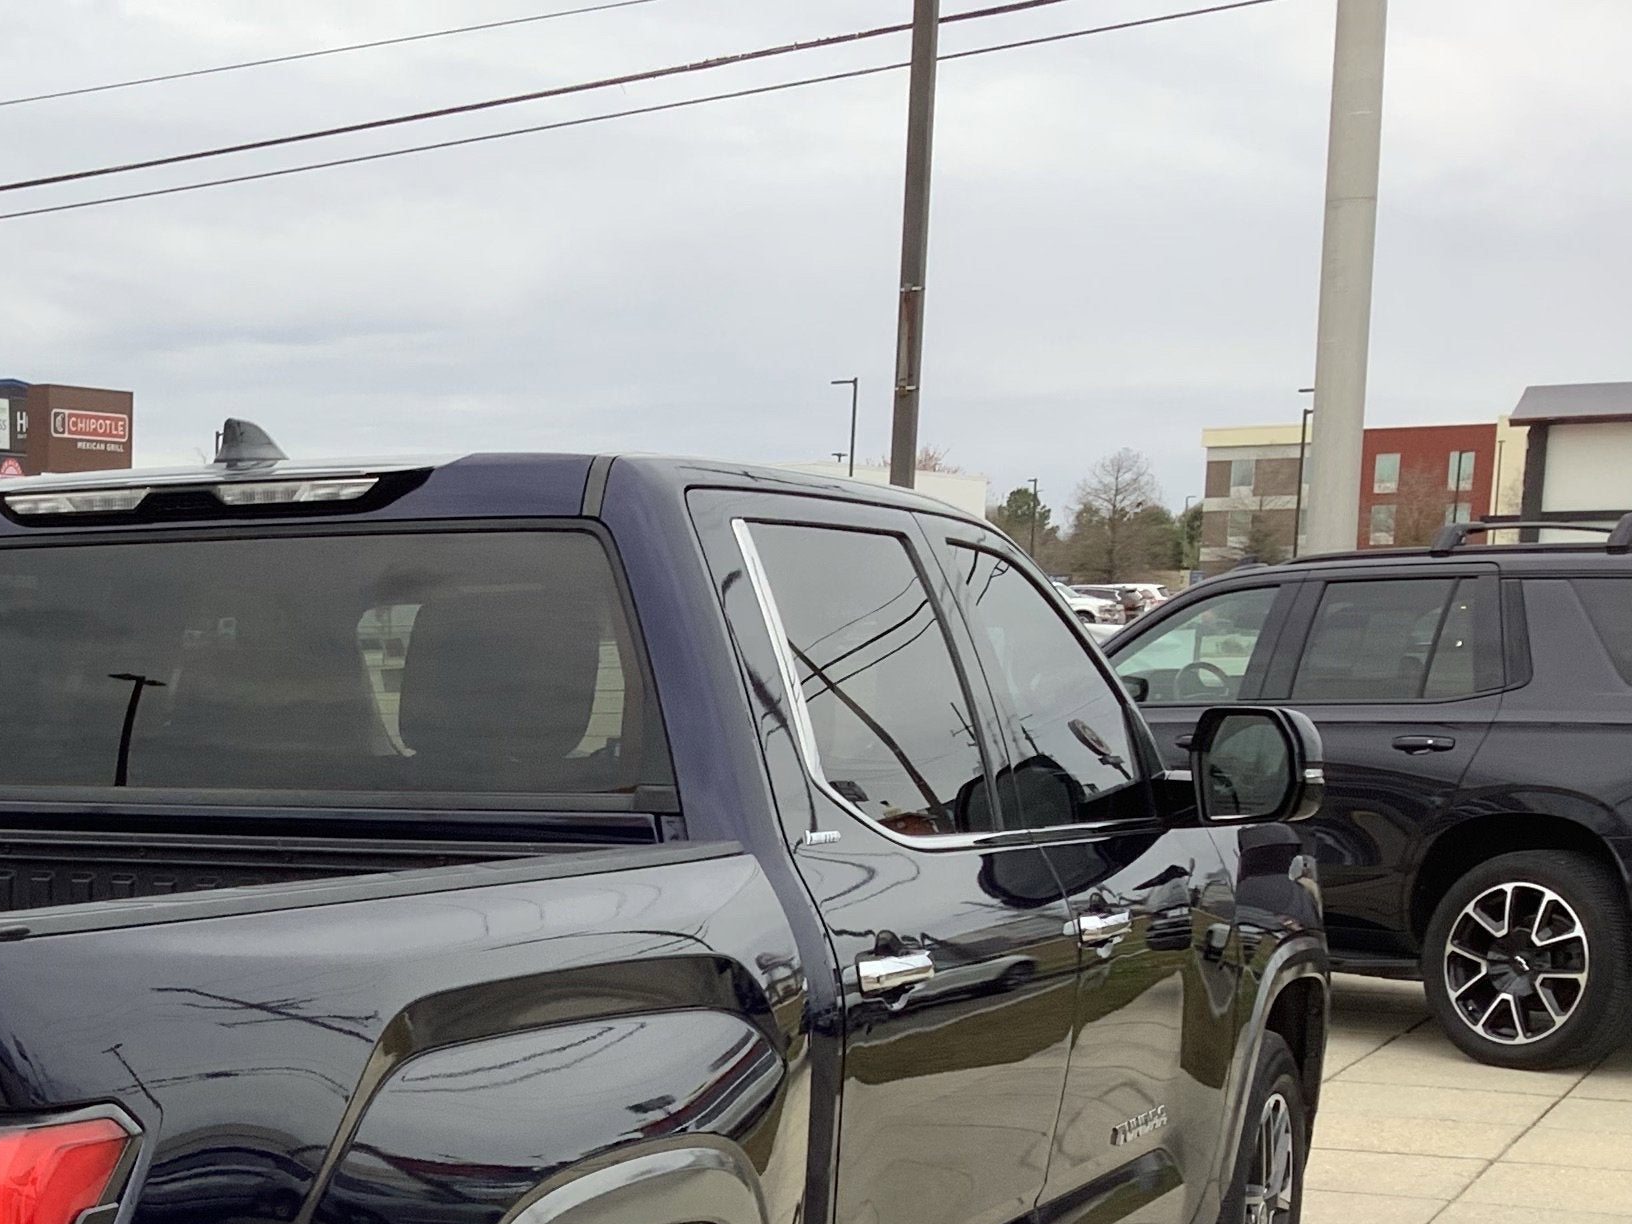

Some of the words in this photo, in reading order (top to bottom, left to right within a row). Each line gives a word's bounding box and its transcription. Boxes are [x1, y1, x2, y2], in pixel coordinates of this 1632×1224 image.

[69, 417, 125, 435] CHIPOTLE
[77, 441, 106, 451] MEXICAN
[106, 443, 124, 452] GRILL
